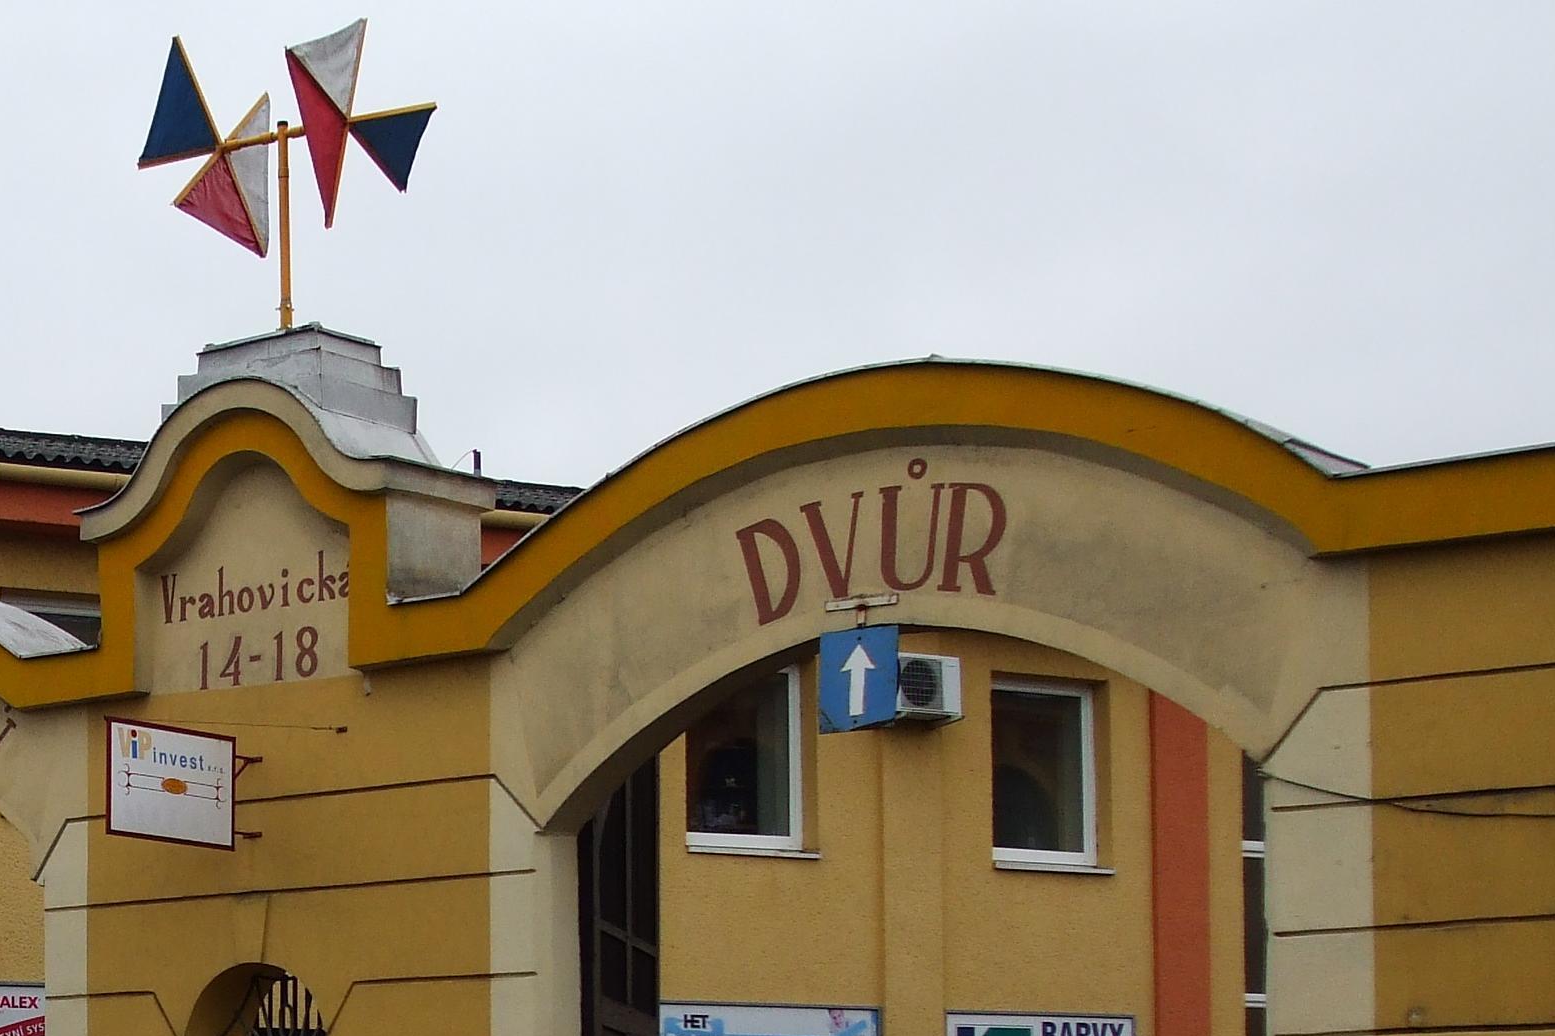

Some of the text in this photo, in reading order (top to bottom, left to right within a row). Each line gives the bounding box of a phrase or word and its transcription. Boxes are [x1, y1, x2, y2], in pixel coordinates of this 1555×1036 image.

[736, 458, 1007, 625] DVŮR
[199, 626, 318, 690] 14-18
[153, 746, 204, 771] invest
[26, 1023, 45, 1035] SYS
[683, 1014, 709, 1029] HET
